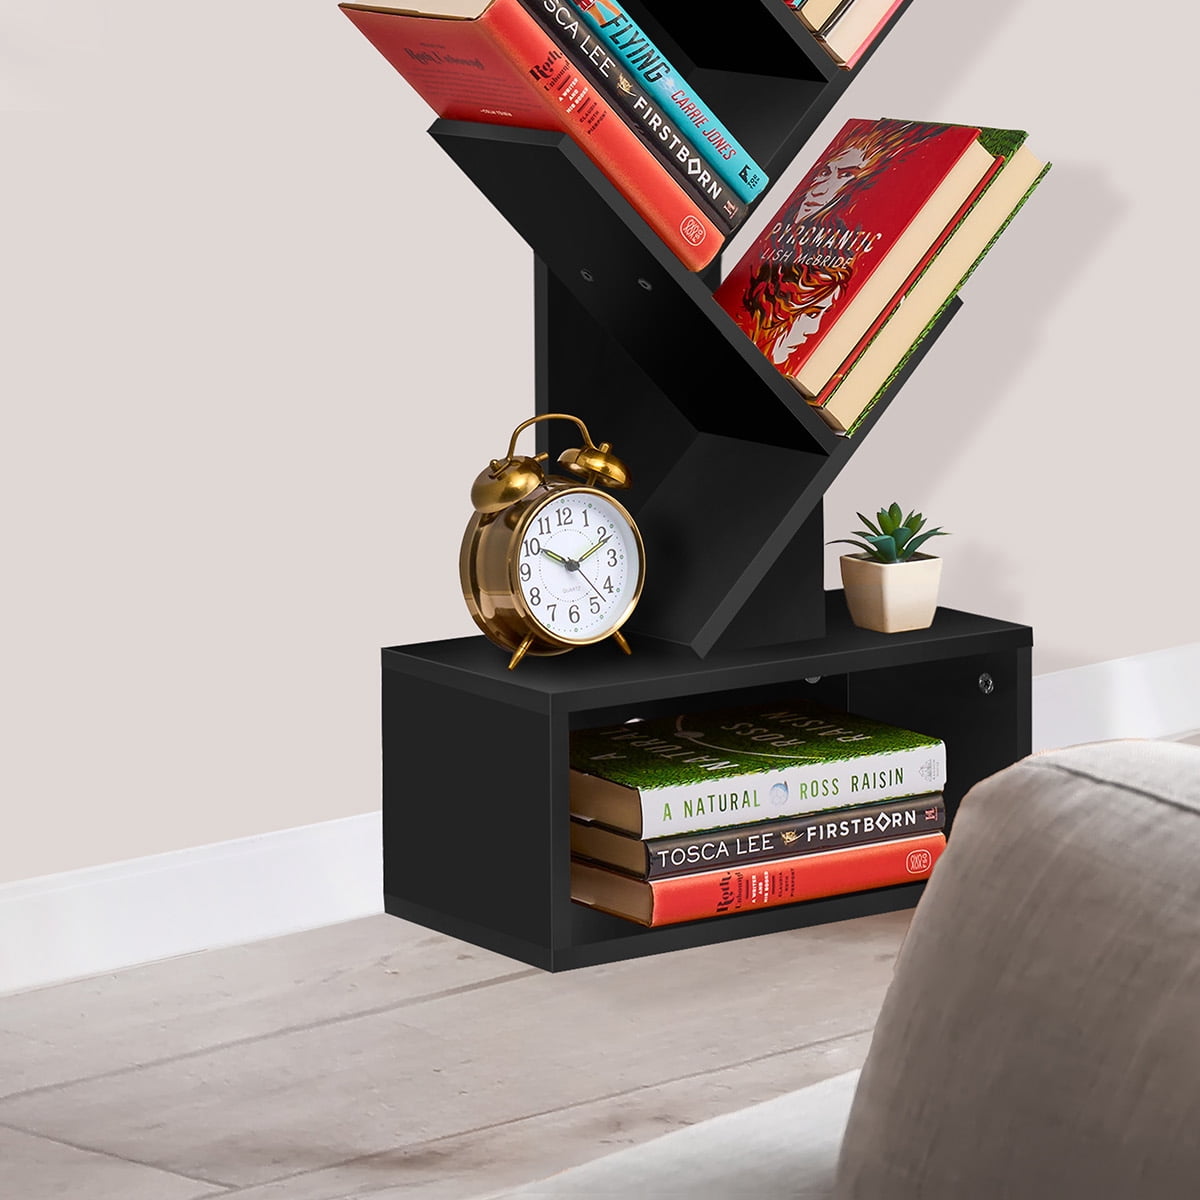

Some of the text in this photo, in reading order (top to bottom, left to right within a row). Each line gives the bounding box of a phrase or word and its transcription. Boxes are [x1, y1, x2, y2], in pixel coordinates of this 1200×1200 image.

[600, 13, 671, 83] FLYING
[580, 35, 617, 79] LEE
[632, 96, 722, 200] FIRSTBORN
[670, 90, 709, 130] CARRIE
[702, 128, 736, 161] JONES
[764, 222, 883, 253] PYROMANTIC
[761, 247, 854, 269] LISH McBRIDE
[537, 516, 552, 536] 11
[556, 507, 573, 527] 12
[582, 509, 590, 527] 1
[597, 526, 608, 543] 2
[523, 537, 541, 558] 10
[607, 548, 618, 567] 3
[520, 562, 532, 582] 9
[603, 575, 614, 594] 4
[529, 586, 541, 606] 8
[589, 596, 601, 614] 5
[547, 604, 557, 622] 7
[568, 604, 580, 623] 6
[663, 802, 672, 821] A
[684, 789, 761, 818] NATURAL
[800, 778, 839, 800] ROSS
[851, 767, 904, 793] RAISIN
[657, 840, 729, 868] TOSCA
[736, 833, 774, 855] LEE
[807, 810, 916, 842] FIRSTBORN
